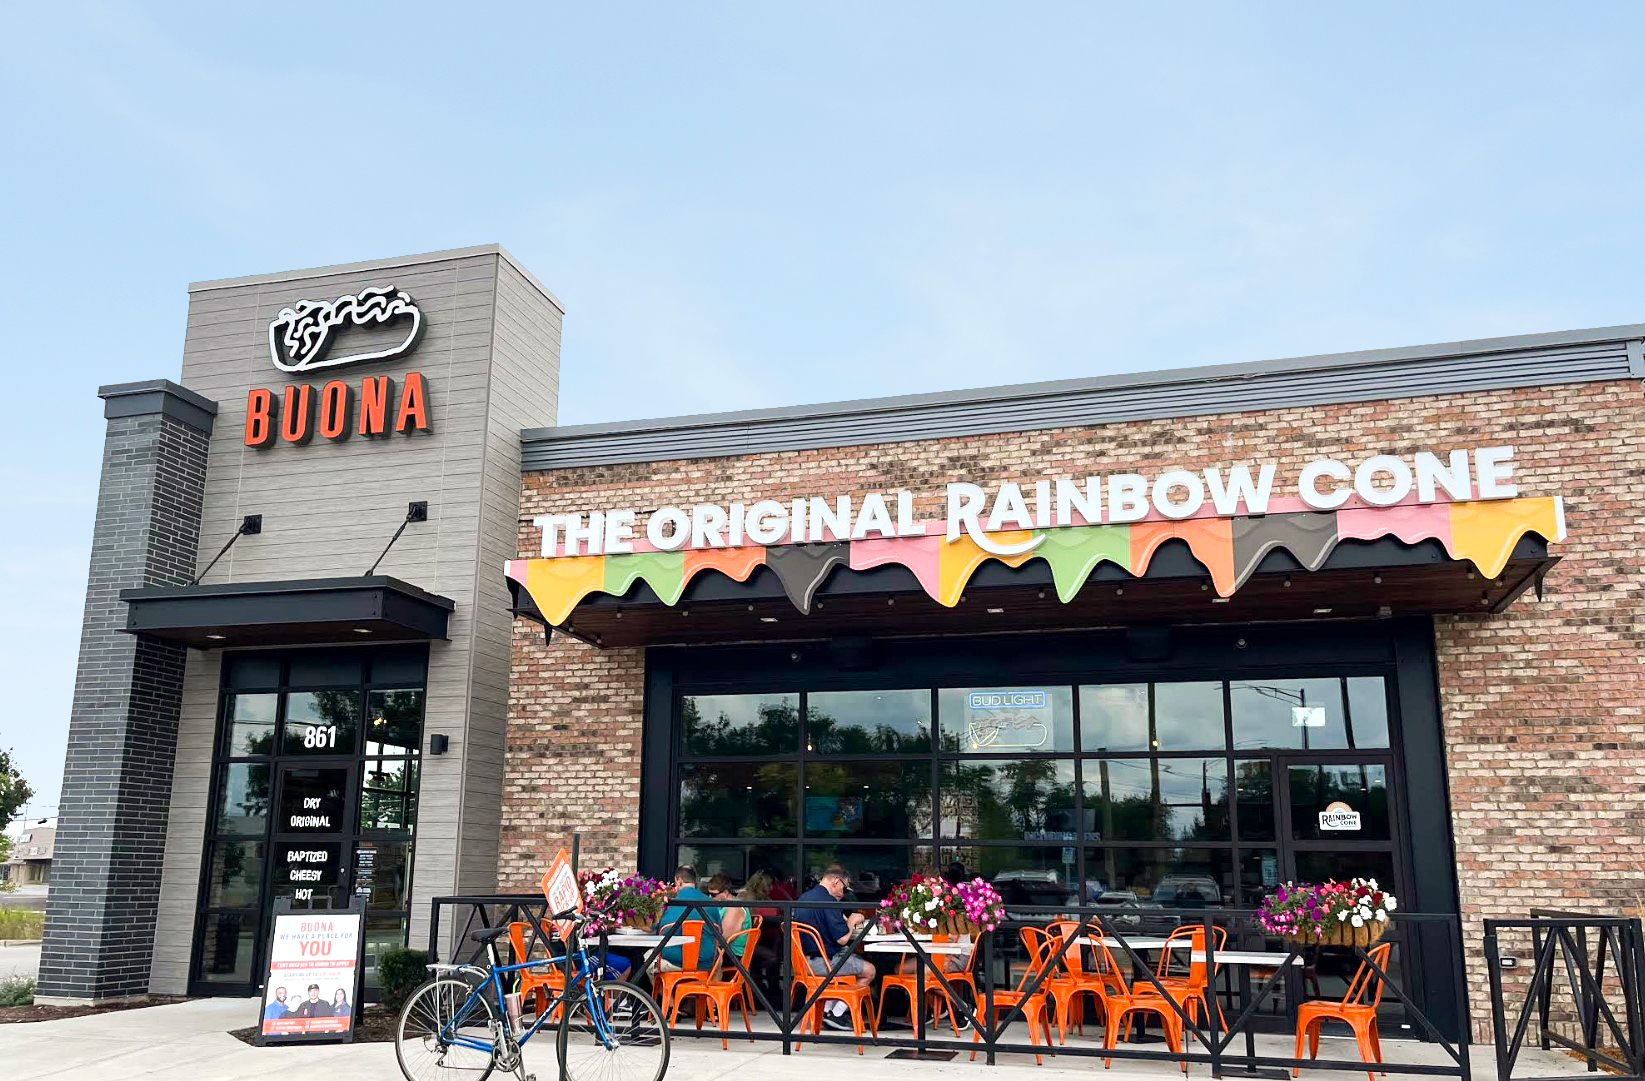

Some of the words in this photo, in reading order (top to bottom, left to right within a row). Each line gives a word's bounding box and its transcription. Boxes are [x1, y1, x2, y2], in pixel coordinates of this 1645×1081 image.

[244, 371, 430, 447] BUONA
[533, 508, 635, 558] THE
[647, 489, 926, 552] ORIGINAL
[945, 464, 1277, 556] RAINBOW
[1298, 445, 1519, 511] CONE
[972, 695, 1001, 706] BUD
[1003, 694, 1043, 705] LIGHT
[304, 725, 337, 748] 861
[303, 797, 321, 809] DRY
[290, 815, 331, 828] ORIGINAL
[1321, 814, 1357, 827] RAINBOW
[287, 850, 328, 862] BAPTIZED
[289, 869, 322, 882] CHEESY
[295, 888, 313, 900] HOT
[554, 875, 572, 911] RAPID
[301, 922, 333, 932] BUONA
[317, 932, 338, 940] PLACE
[299, 940, 332, 956] YOU
